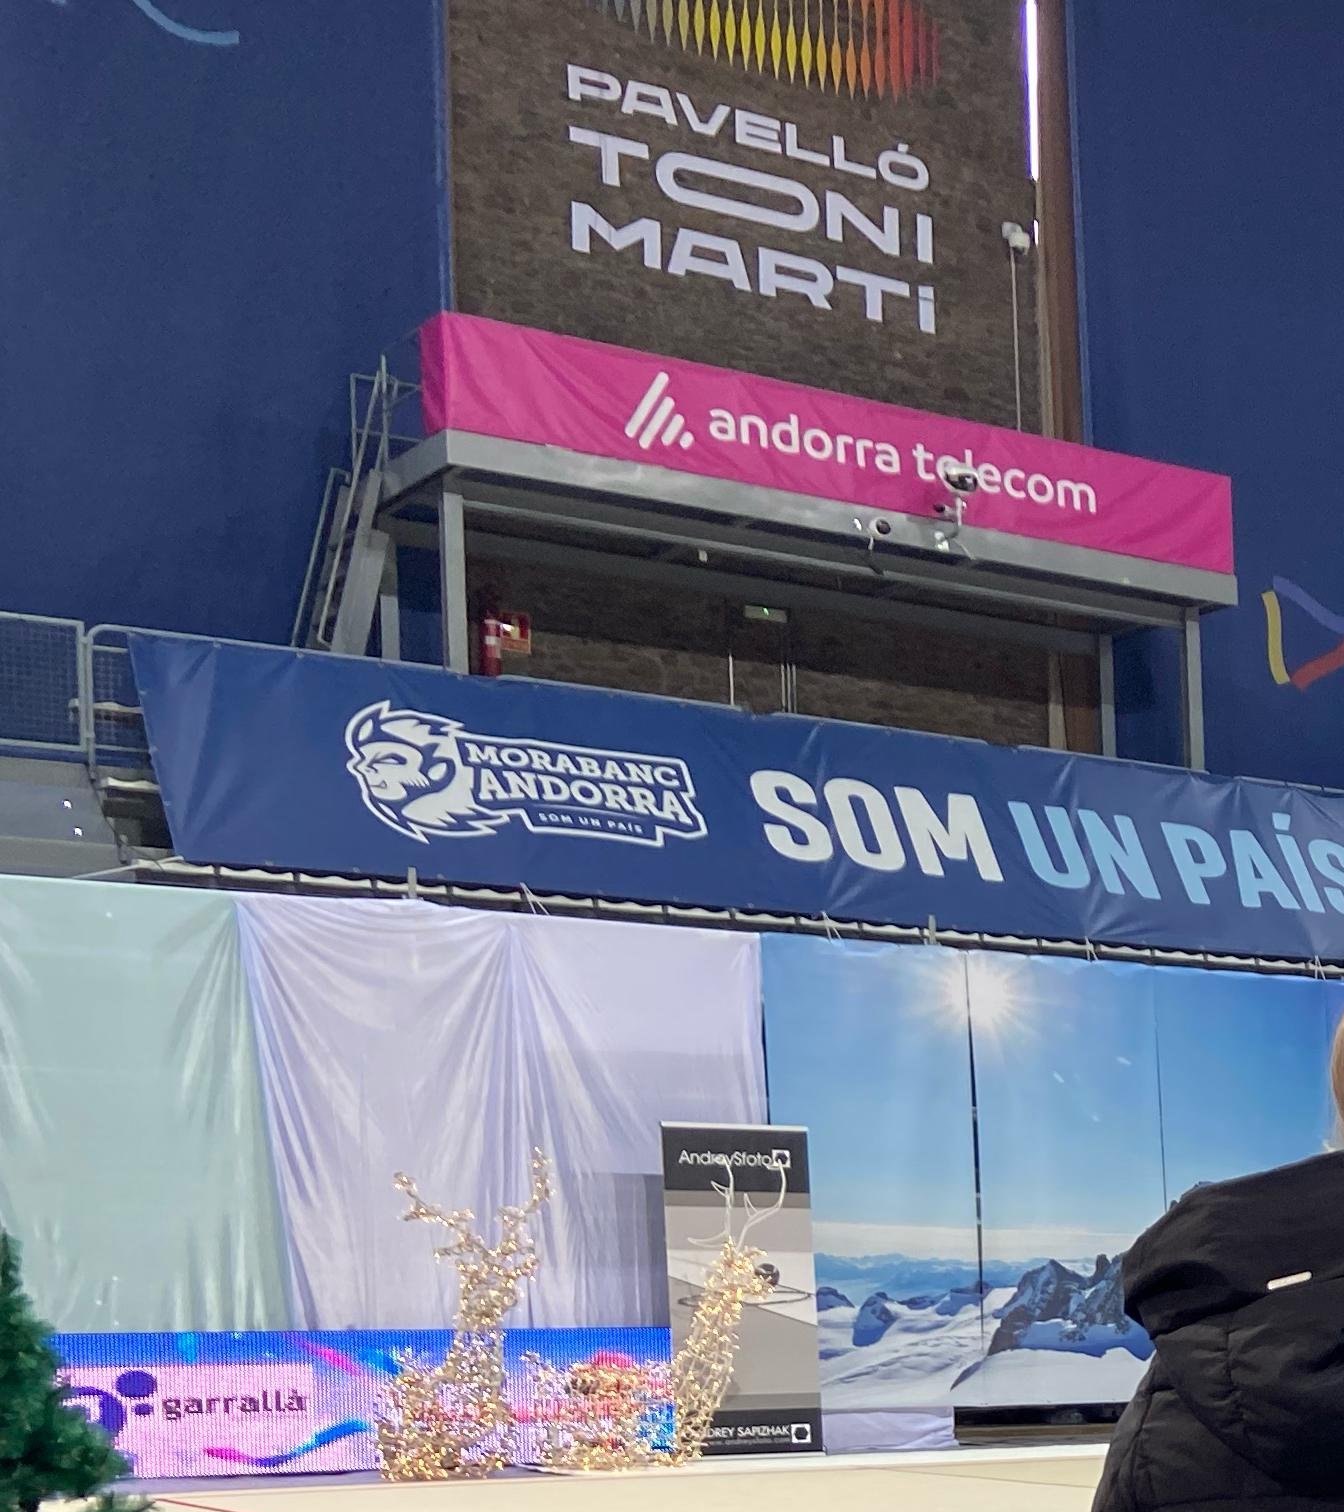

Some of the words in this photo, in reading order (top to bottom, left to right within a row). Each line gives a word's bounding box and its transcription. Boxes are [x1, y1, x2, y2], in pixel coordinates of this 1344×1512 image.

[567, 63, 930, 191] PAVELLÓ
[568, 125, 934, 264] TONI
[709, 407, 899, 475] andorra
[464, 742, 681, 787] MORABANC
[479, 768, 694, 826] ANDORRA
[538, 812, 574, 825] SOM
[579, 816, 601, 828] UN
[750, 769, 1004, 883] SOM
[1007, 801, 1161, 900] UN
